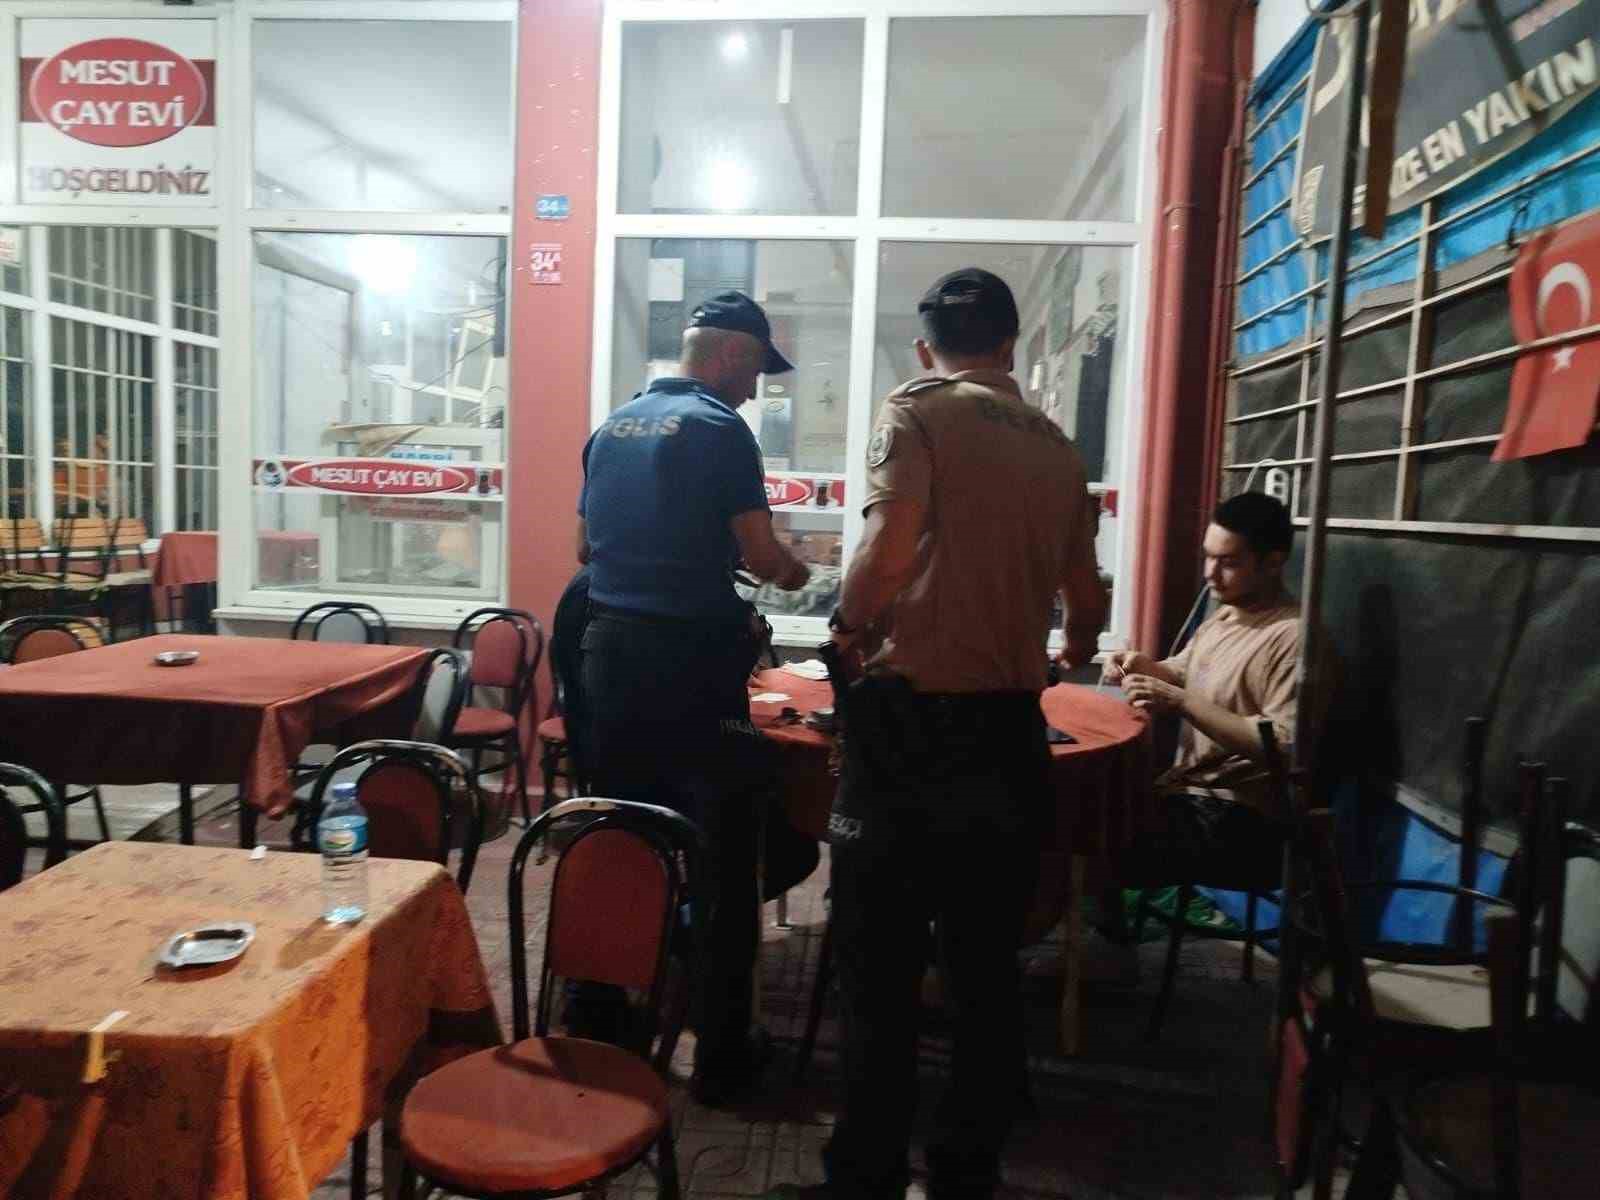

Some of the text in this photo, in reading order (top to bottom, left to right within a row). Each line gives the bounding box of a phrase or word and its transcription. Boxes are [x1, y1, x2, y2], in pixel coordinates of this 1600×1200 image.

[58, 59, 176, 85] MESUT
[51, 95, 185, 131] ÇAY EVİ
[1423, 121, 1465, 172] EN
[1462, 38, 1598, 144] YAKIN
[311, 467, 442, 489] MESUT ÇAY EVİ
